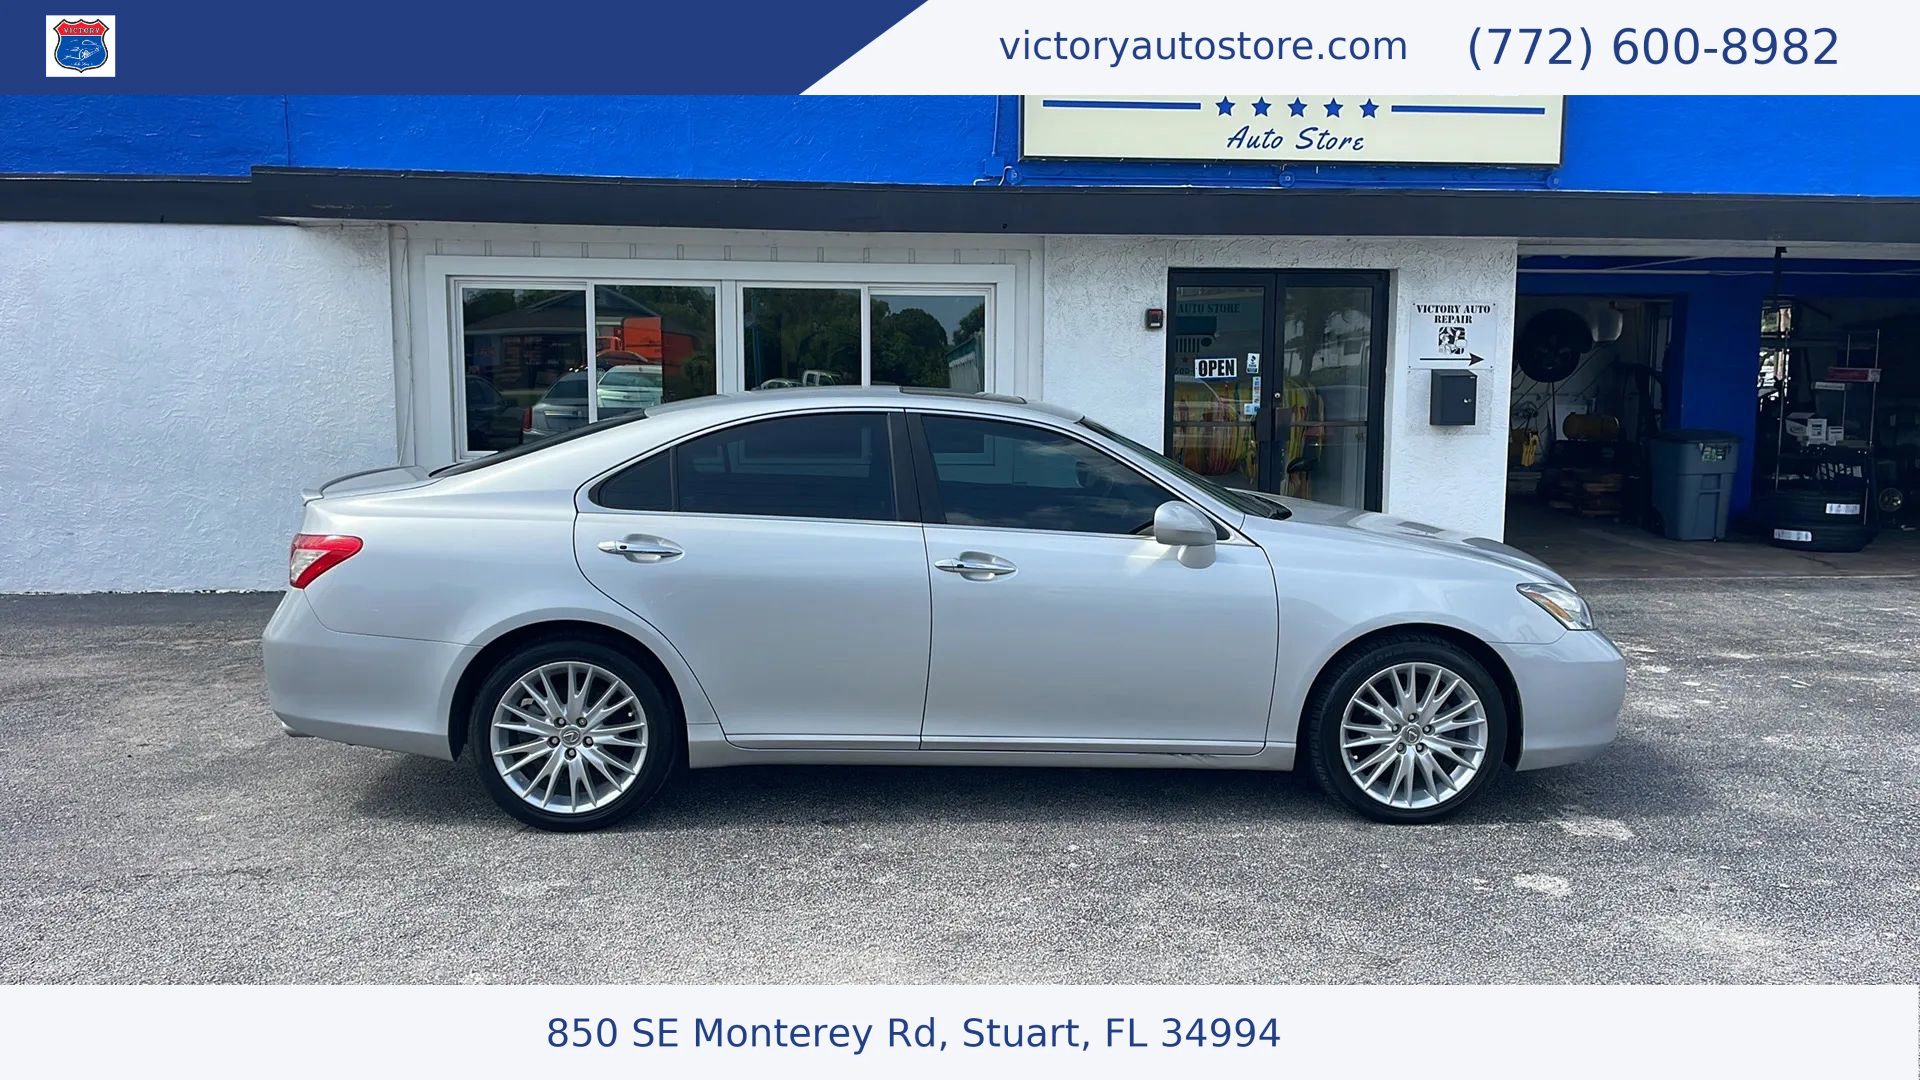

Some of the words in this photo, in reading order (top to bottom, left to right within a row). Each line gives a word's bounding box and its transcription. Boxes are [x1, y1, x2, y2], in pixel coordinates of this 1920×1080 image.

[1226, 125, 1284, 151] Auto
[1294, 126, 1365, 152] Store
[1177, 303, 1204, 313] AUTO
[1207, 303, 1241, 313] STORE
[1416, 304, 1461, 314] VICTORY
[1463, 304, 1491, 314] AUTO
[1434, 314, 1473, 324] REPAIR
[1198, 359, 1235, 377] OPEN
